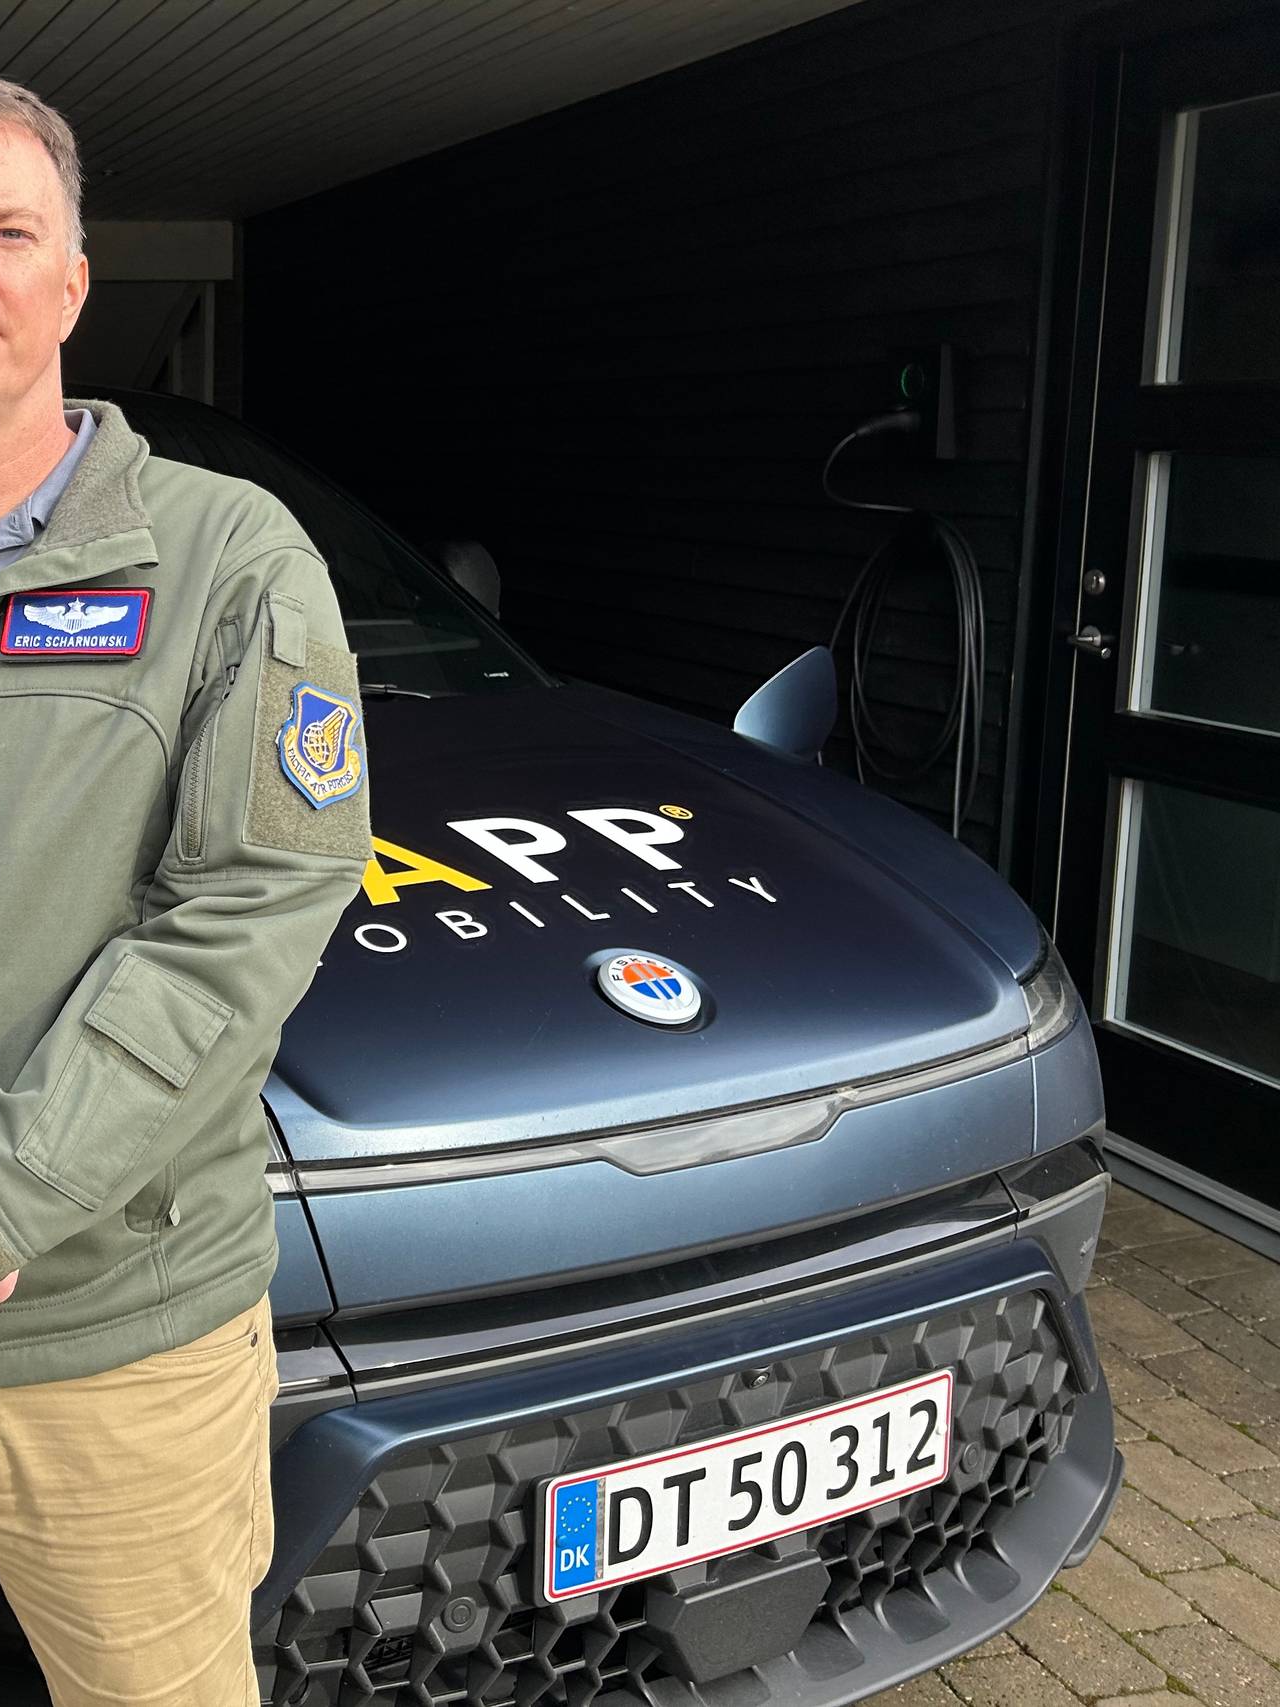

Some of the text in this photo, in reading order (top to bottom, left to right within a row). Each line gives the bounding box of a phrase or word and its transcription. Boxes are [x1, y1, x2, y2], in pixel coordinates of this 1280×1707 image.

[14, 636, 128, 648] ERIC SCHARNOWSKI
[361, 807, 685, 906] APP
[317, 876, 777, 967] OBILITY
[608, 1399, 939, 1566] DT 50 312
[560, 1544, 590, 1572] DK
